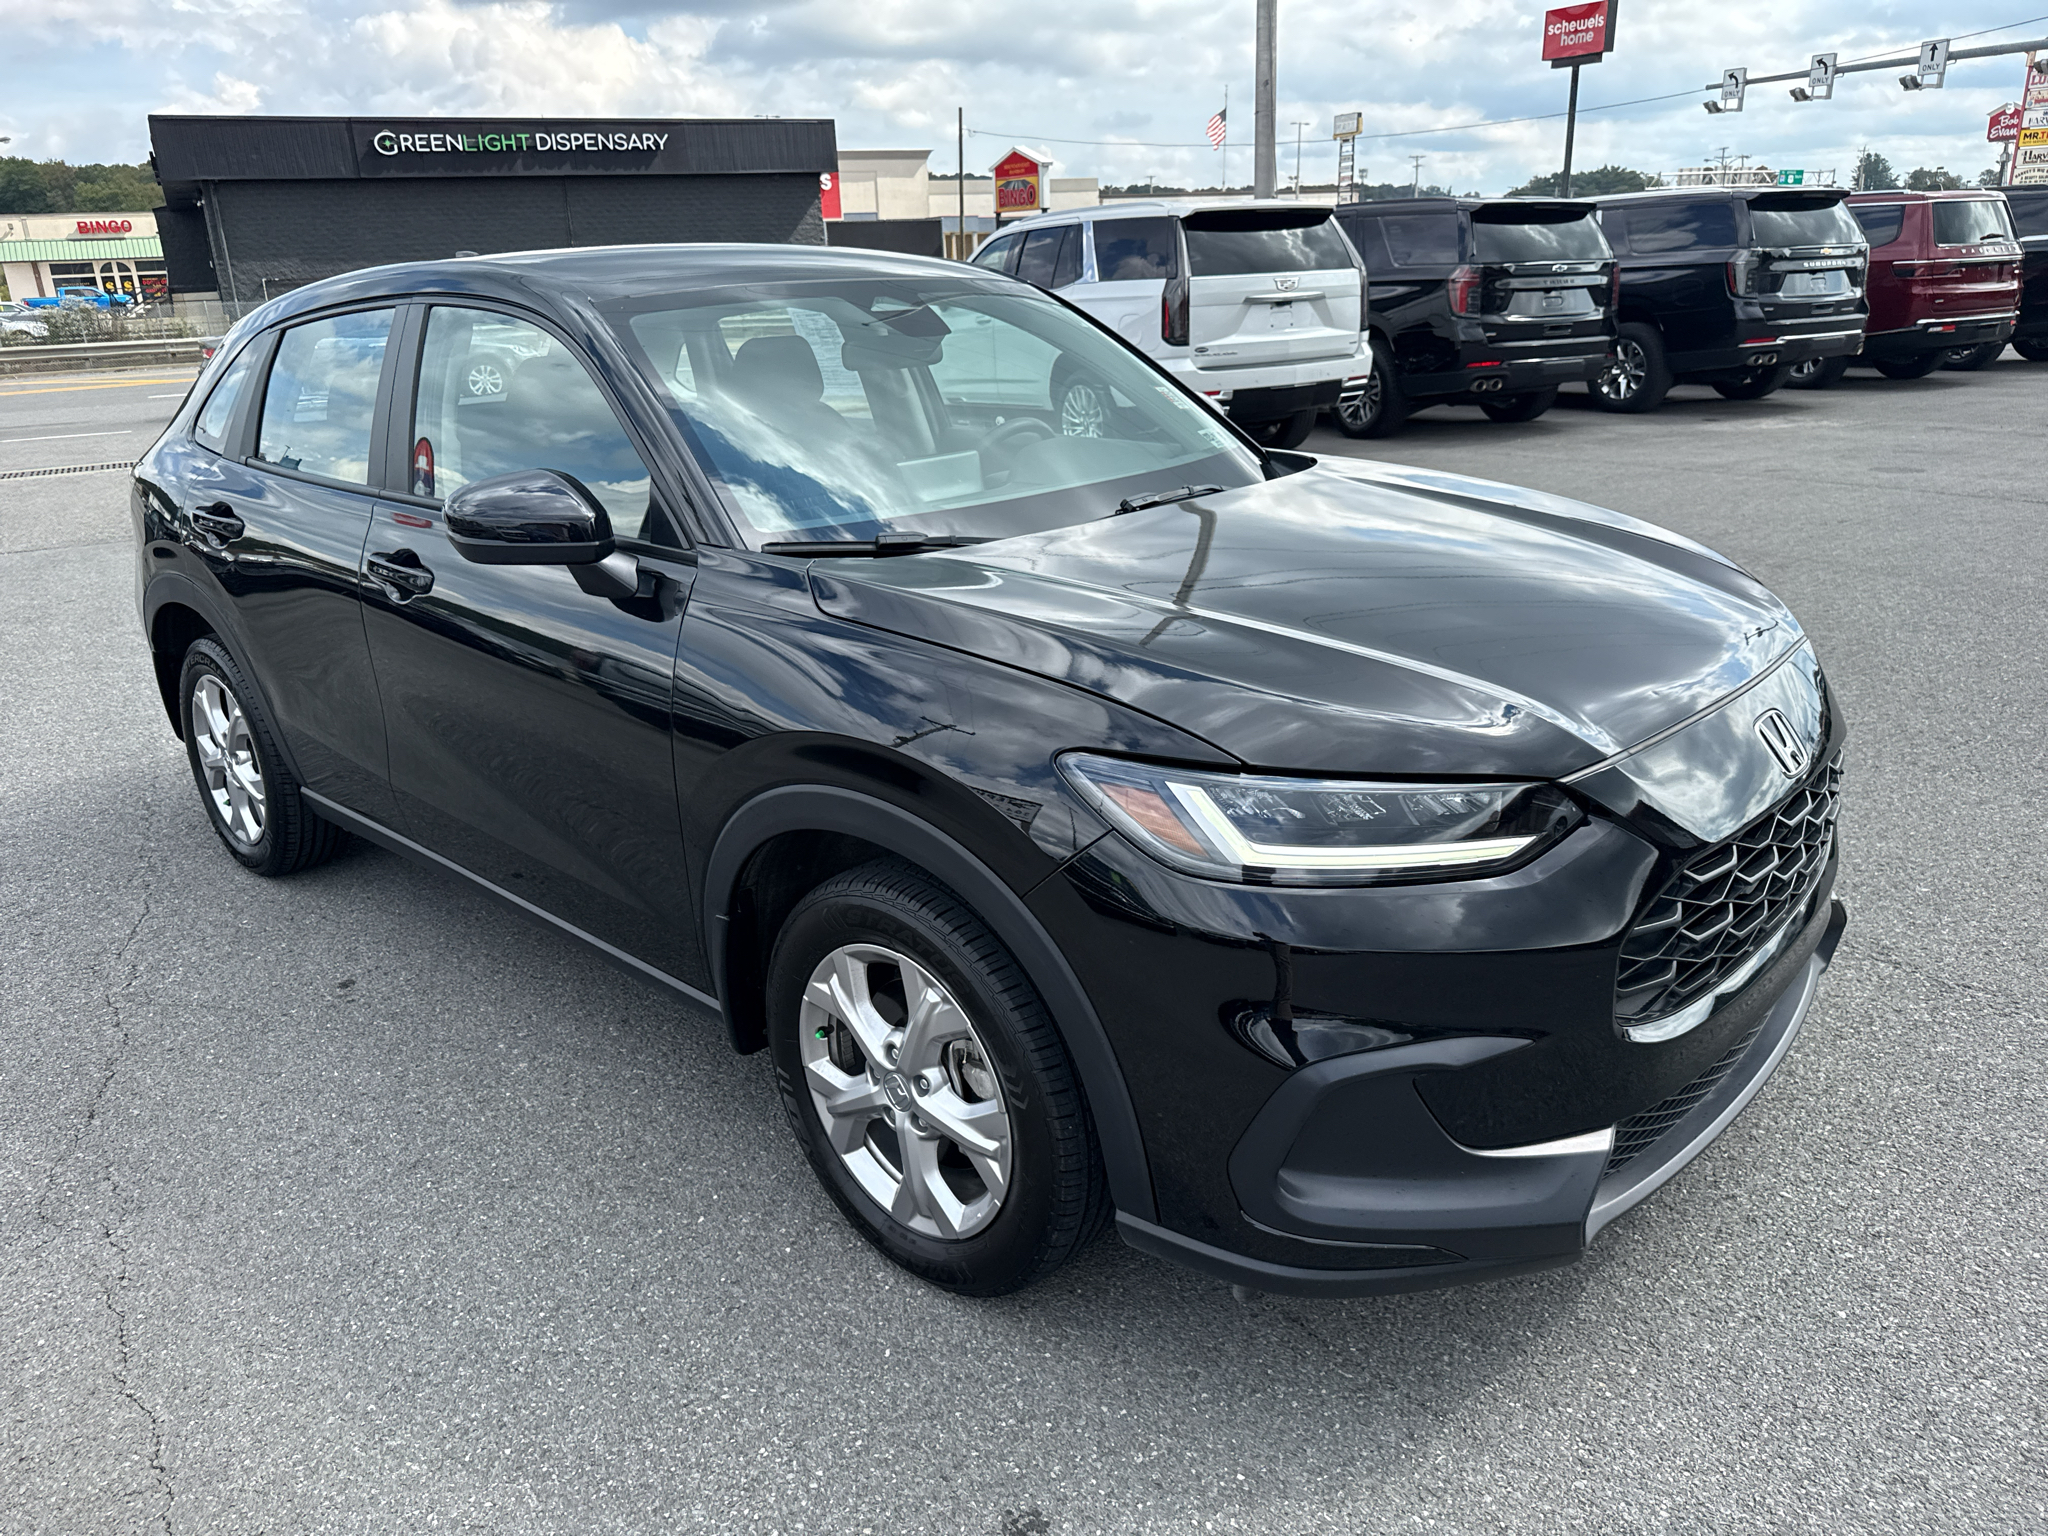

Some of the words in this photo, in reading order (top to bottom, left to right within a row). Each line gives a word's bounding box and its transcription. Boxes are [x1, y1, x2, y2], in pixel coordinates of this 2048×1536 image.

[1548, 14, 1604, 35] schewels
[1560, 31, 1594, 46] home
[1922, 62, 1940, 71] ONLY
[1811, 77, 1829, 85] ONLY
[2031, 74, 2048, 86] LU
[1724, 90, 1740, 98] ONLY
[1998, 115, 2018, 126] Bob
[374, 131, 530, 156] GREENLIGHT
[535, 133, 669, 151] DISPENSARY
[820, 173, 832, 190] S
[998, 184, 1036, 208] BINGO
[77, 220, 132, 234] BINGO
